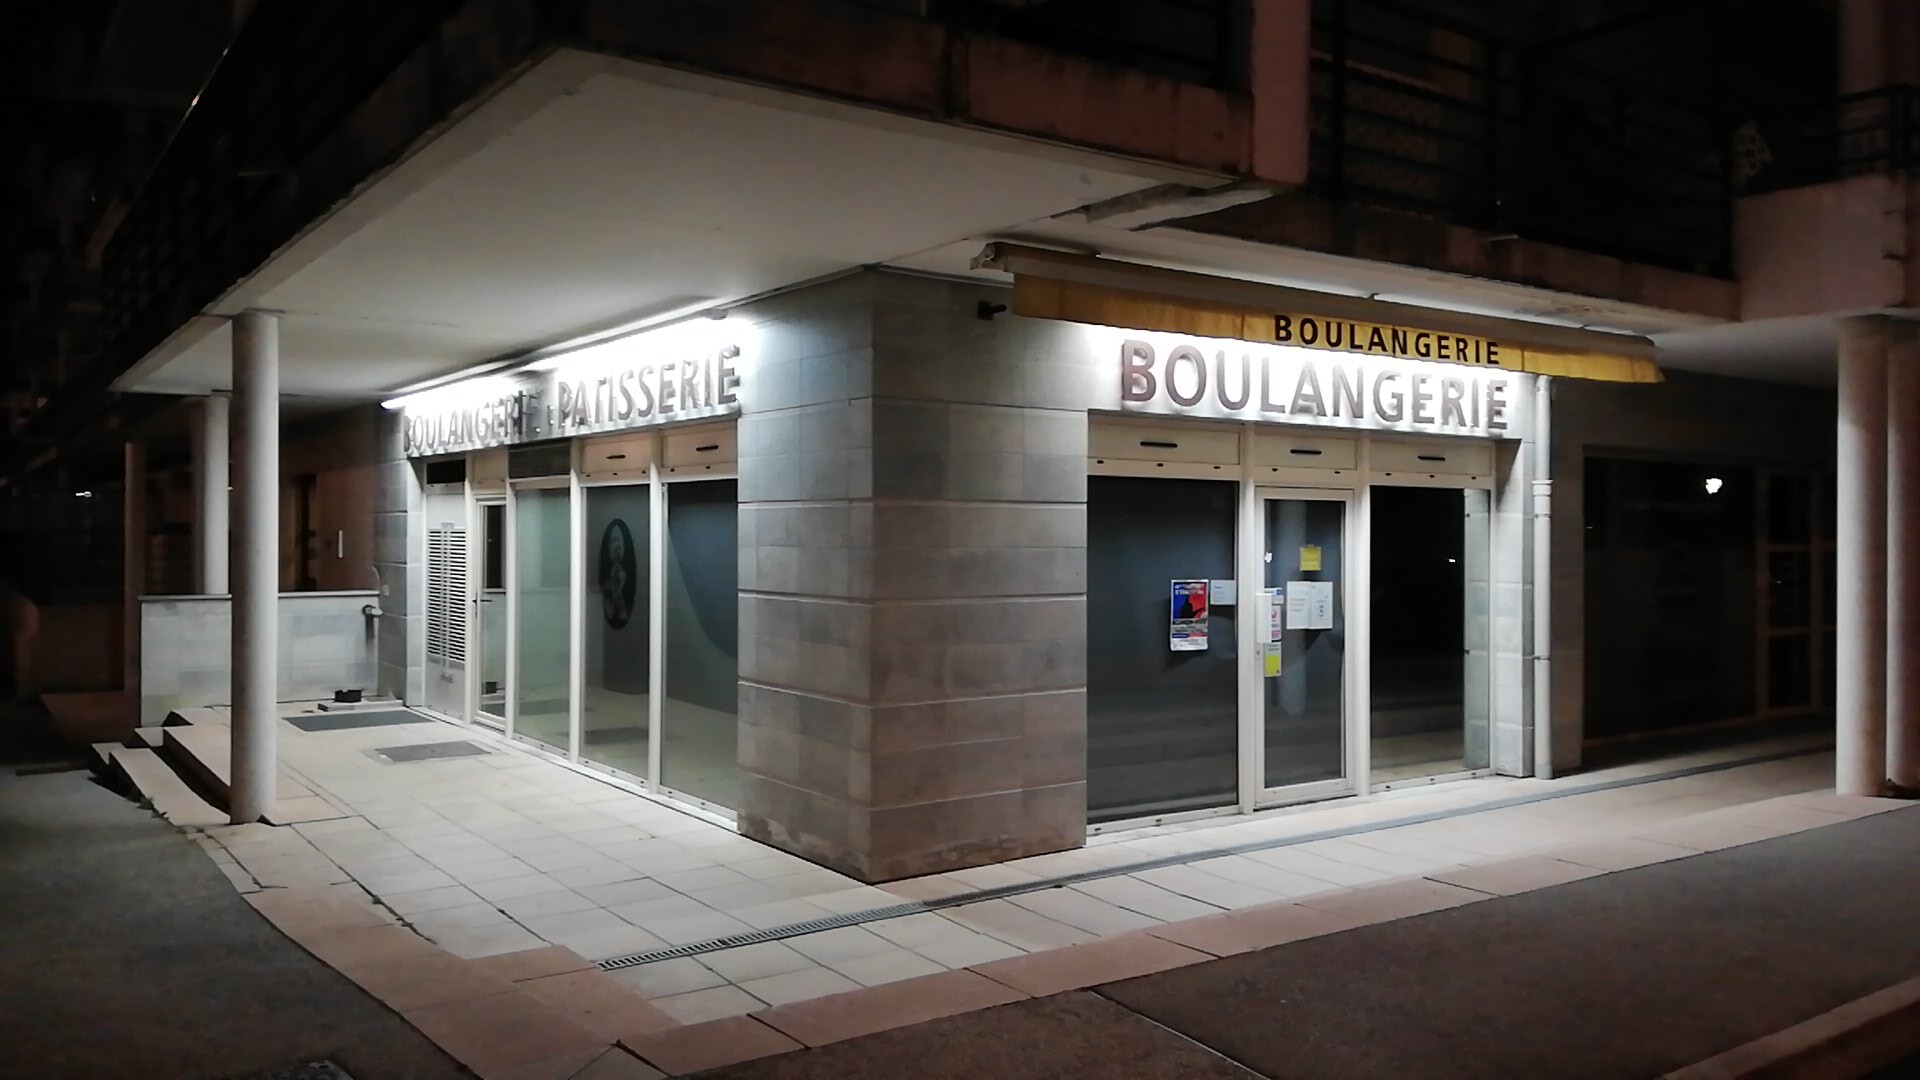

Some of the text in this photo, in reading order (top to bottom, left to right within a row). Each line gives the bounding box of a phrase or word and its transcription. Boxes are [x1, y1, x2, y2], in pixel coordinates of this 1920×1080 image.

[1275, 315, 1500, 364] BOULANGERIE
[557, 343, 741, 430] PATISSERIE
[1121, 339, 1508, 430] BOULANGERIE
